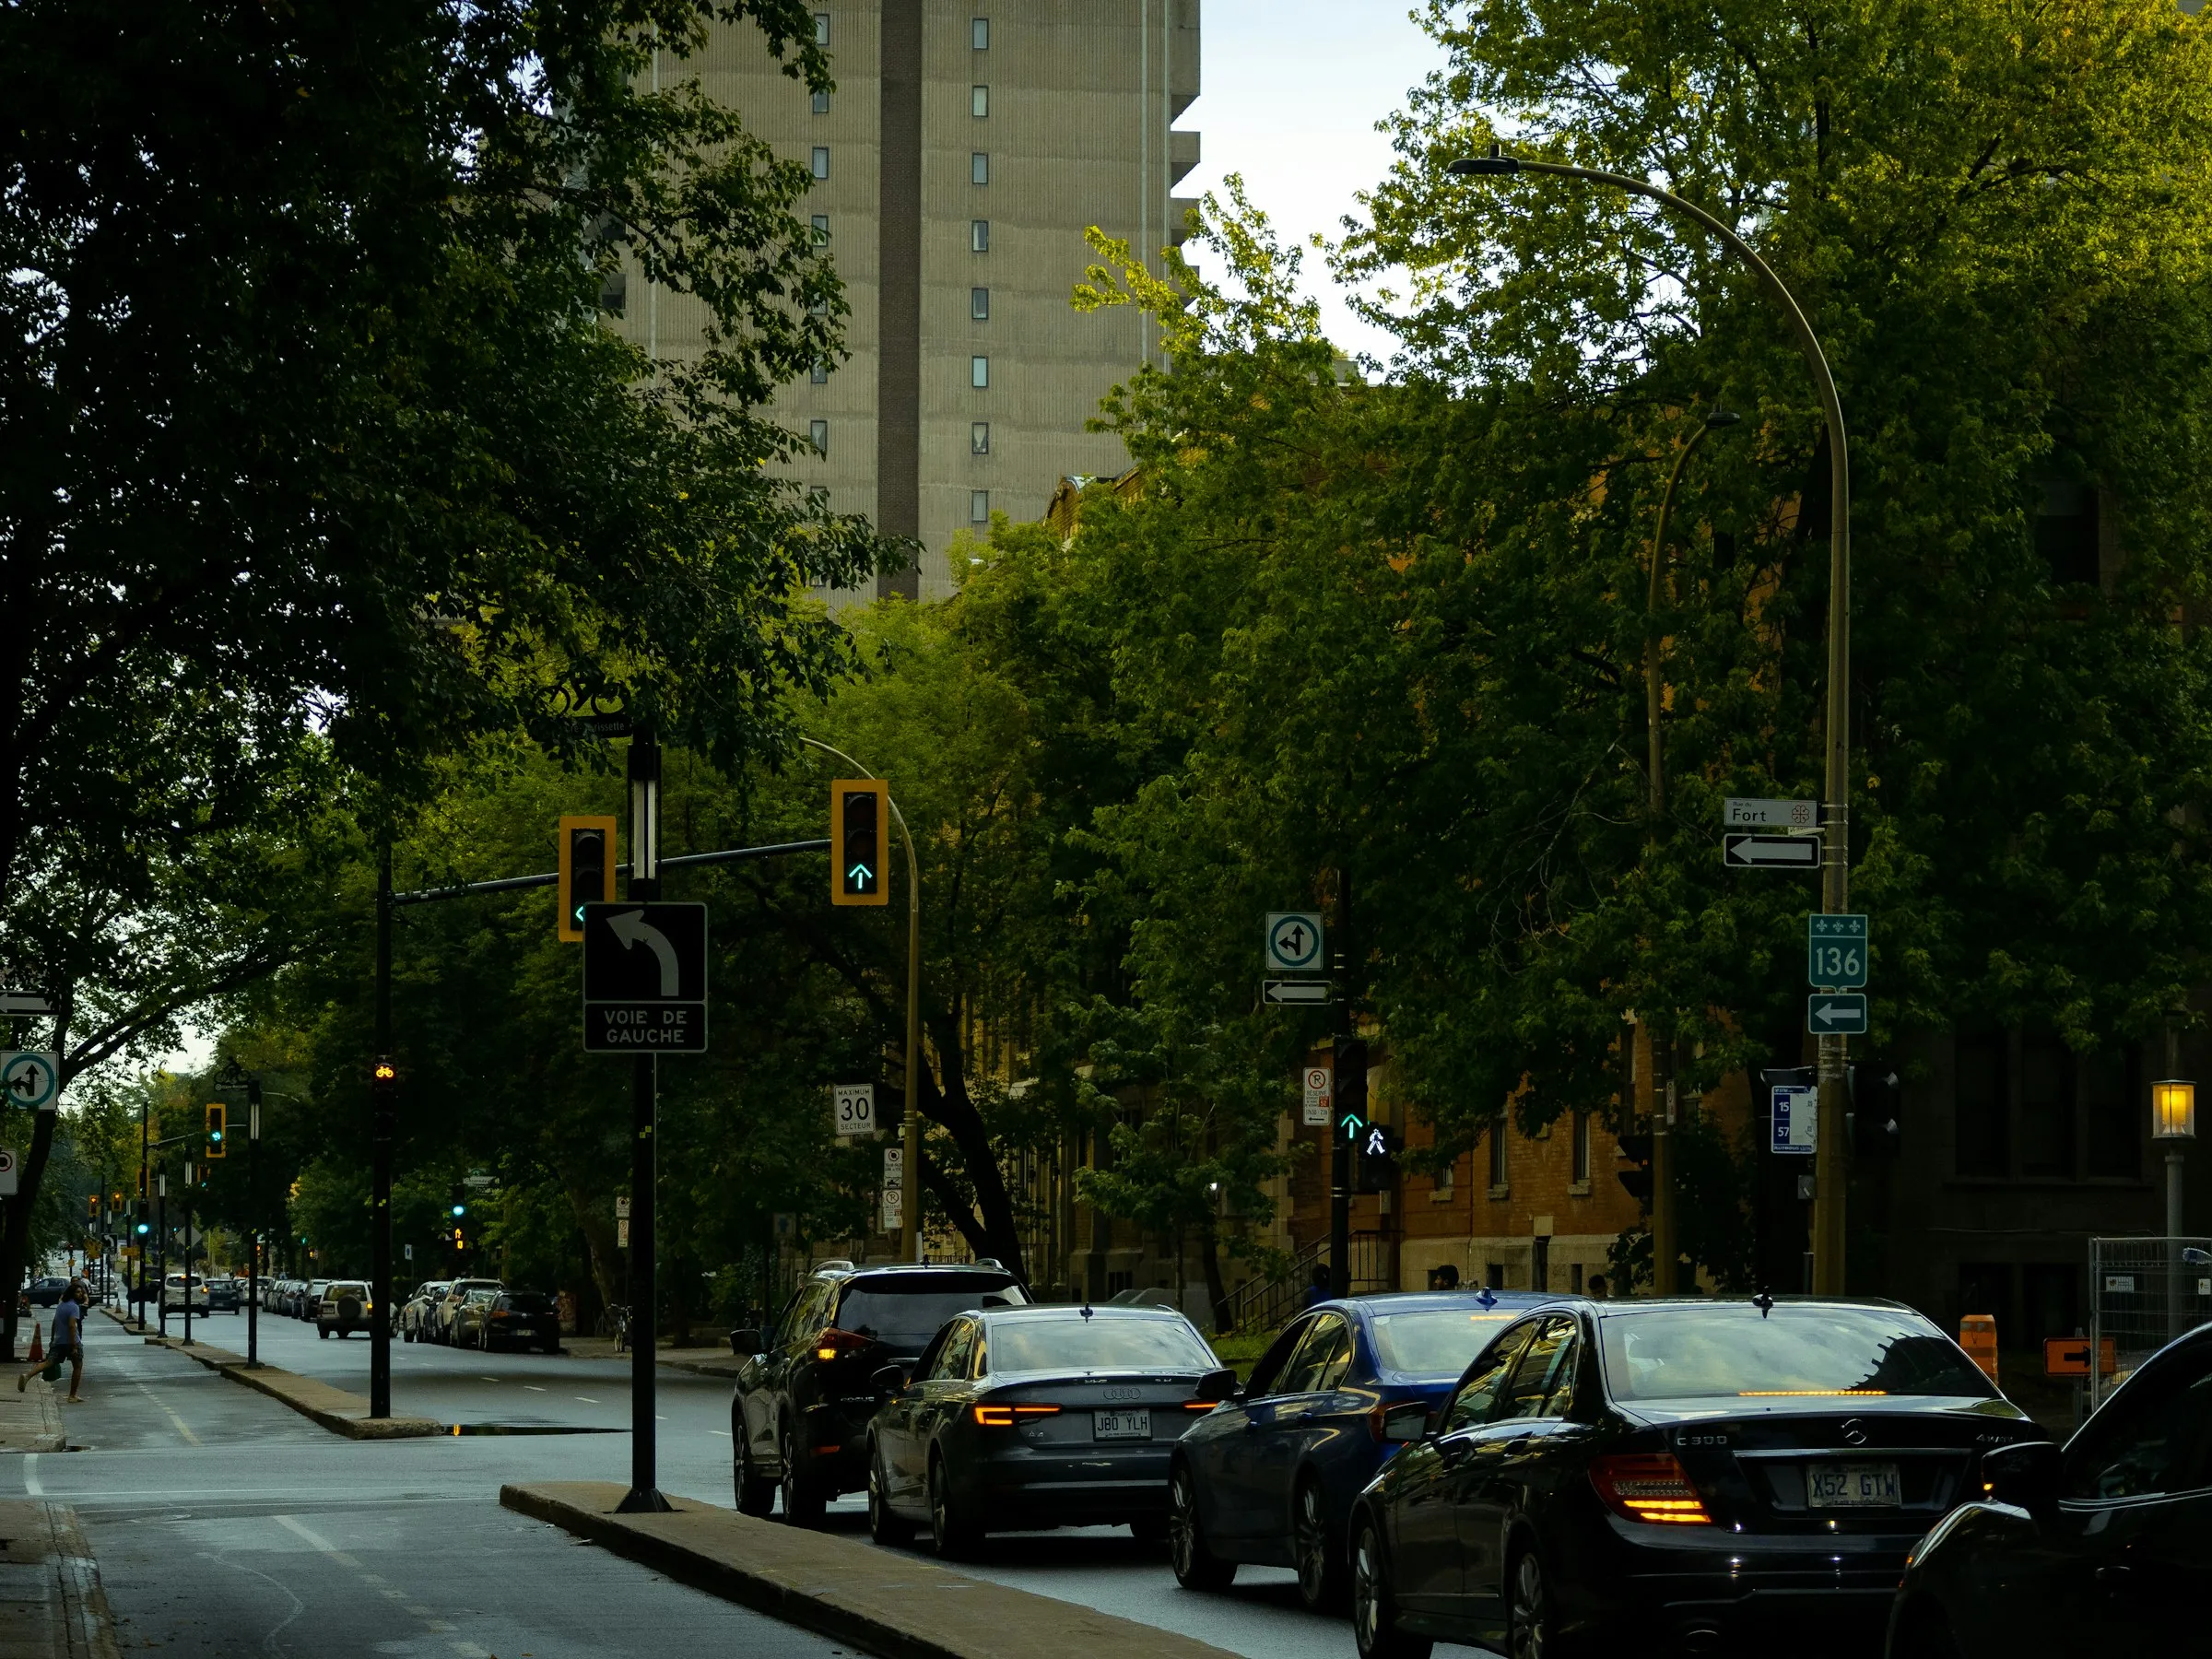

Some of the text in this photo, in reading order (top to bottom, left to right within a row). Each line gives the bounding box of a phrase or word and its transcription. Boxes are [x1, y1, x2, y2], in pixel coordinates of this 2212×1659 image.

[1733, 808, 1767, 822] Fort
[1816, 947, 1861, 977] 136
[604, 1009, 688, 1025] VOIE DE
[606, 1029, 685, 1043] GAUCHE
[841, 1097, 869, 1121] 30
[1779, 1101, 1789, 1112] 15
[840, 1123, 871, 1131] SECTEUR
[1777, 1126, 1790, 1137] 57
[1097, 1416, 1147, 1431] J80 YLH
[1812, 1474, 1895, 1498] X52 GTW
